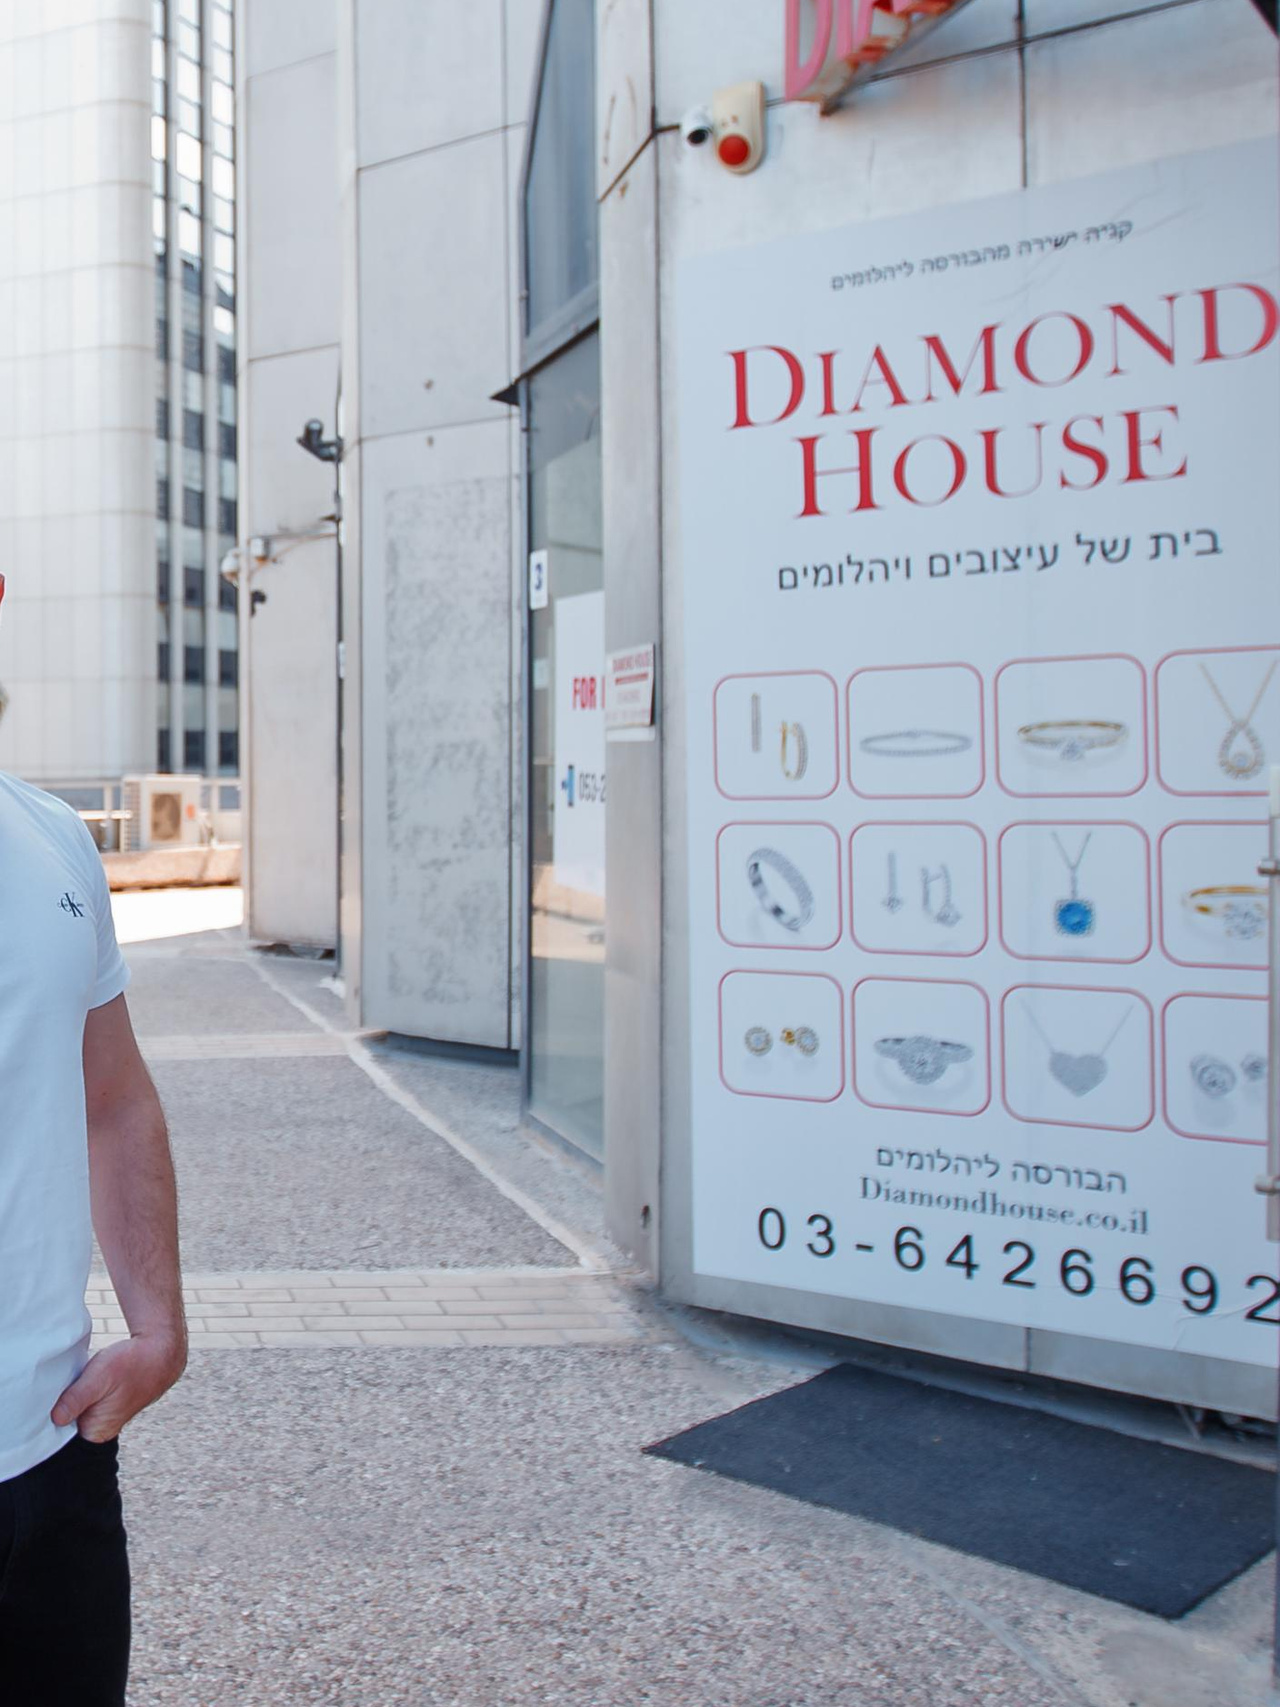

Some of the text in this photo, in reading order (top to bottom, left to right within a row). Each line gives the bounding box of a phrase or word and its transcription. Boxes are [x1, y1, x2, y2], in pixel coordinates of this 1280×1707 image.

[830, 220, 1133, 291] קניה ישירה מהבורסה ליהלומים
[724, 281, 1280, 431] DIAMOND
[792, 404, 1188, 519] HOUSE
[534, 562, 543, 591] 3
[778, 528, 1222, 591] בית של עיצובים ויהלומים
[572, 676, 597, 711] FOR
[876, 1147, 1126, 1194] הבורסה ליהלומים
[860, 1175, 1149, 1236] Diamondhouse.co.il
[757, 1206, 1280, 1325] 03-6426692
